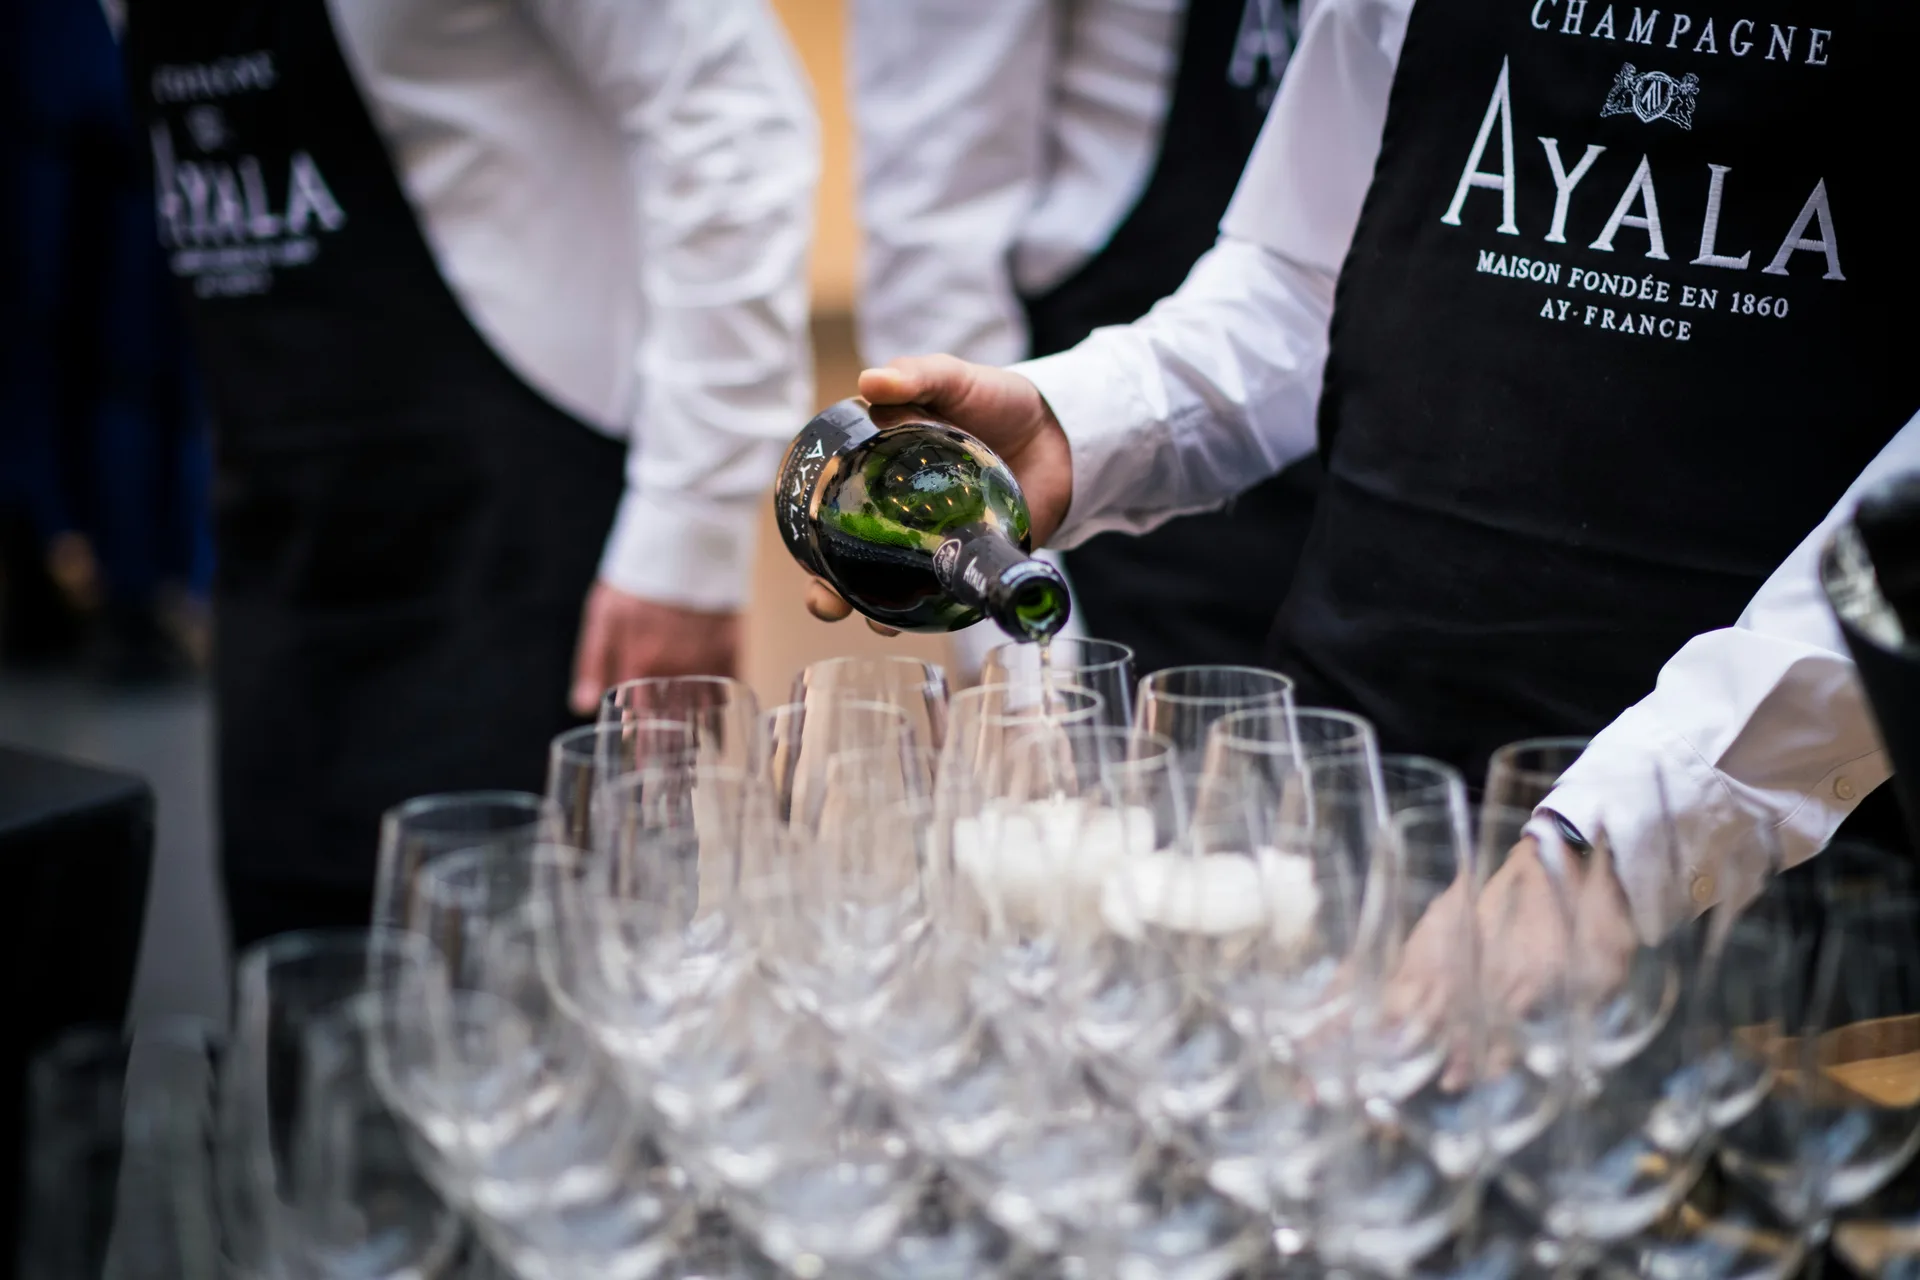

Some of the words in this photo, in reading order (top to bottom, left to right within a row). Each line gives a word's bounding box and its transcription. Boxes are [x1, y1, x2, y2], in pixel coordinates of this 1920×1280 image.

[1530, 0, 1832, 66] CHAMPAGNE
[1441, 54, 1847, 281] AYALA
[1476, 250, 1561, 284] MAISON
[1568, 267, 1671, 303] FONDÉE
[1680, 286, 1718, 310] EN
[1731, 292, 1789, 319] 1860
